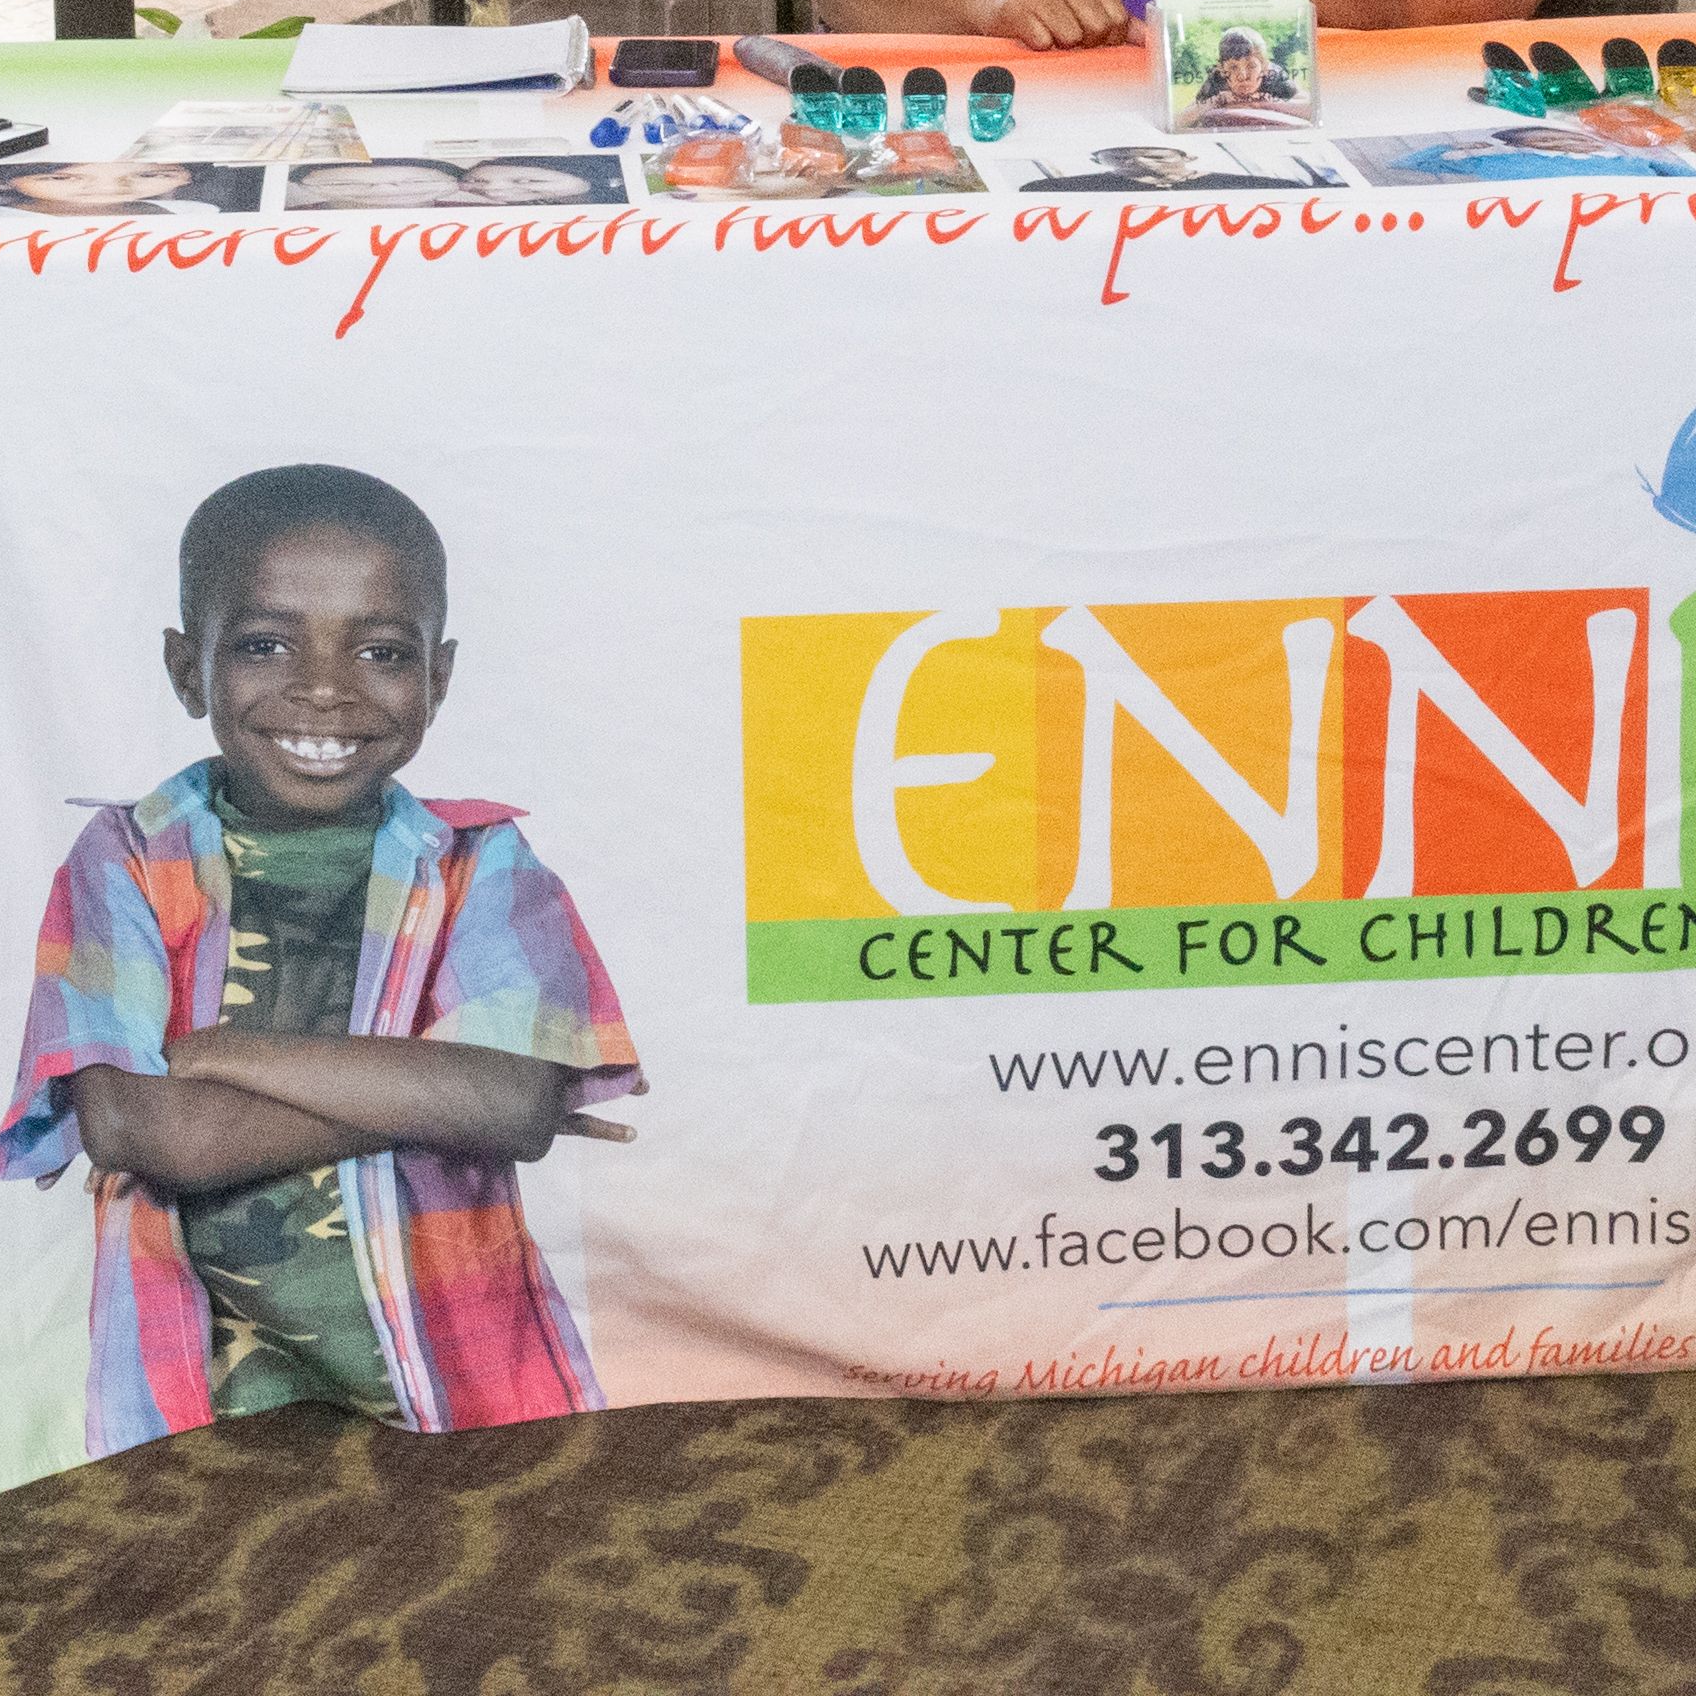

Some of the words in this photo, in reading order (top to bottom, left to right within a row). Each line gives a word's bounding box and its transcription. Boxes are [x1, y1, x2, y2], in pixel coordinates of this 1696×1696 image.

[335, 207, 692, 340] youth
[1012, 204, 1094, 243] a
[1465, 196, 1544, 230] a
[858, 920, 1145, 982] CENTER
[1176, 913, 1329, 974] FOR
[1093, 1103, 1667, 1184] 313.342.2699
[1012, 1344, 1231, 1392] Michigan
[1237, 1331, 1422, 1382] children
[1430, 1325, 1522, 1371] and
[1524, 1321, 1692, 1376] families
